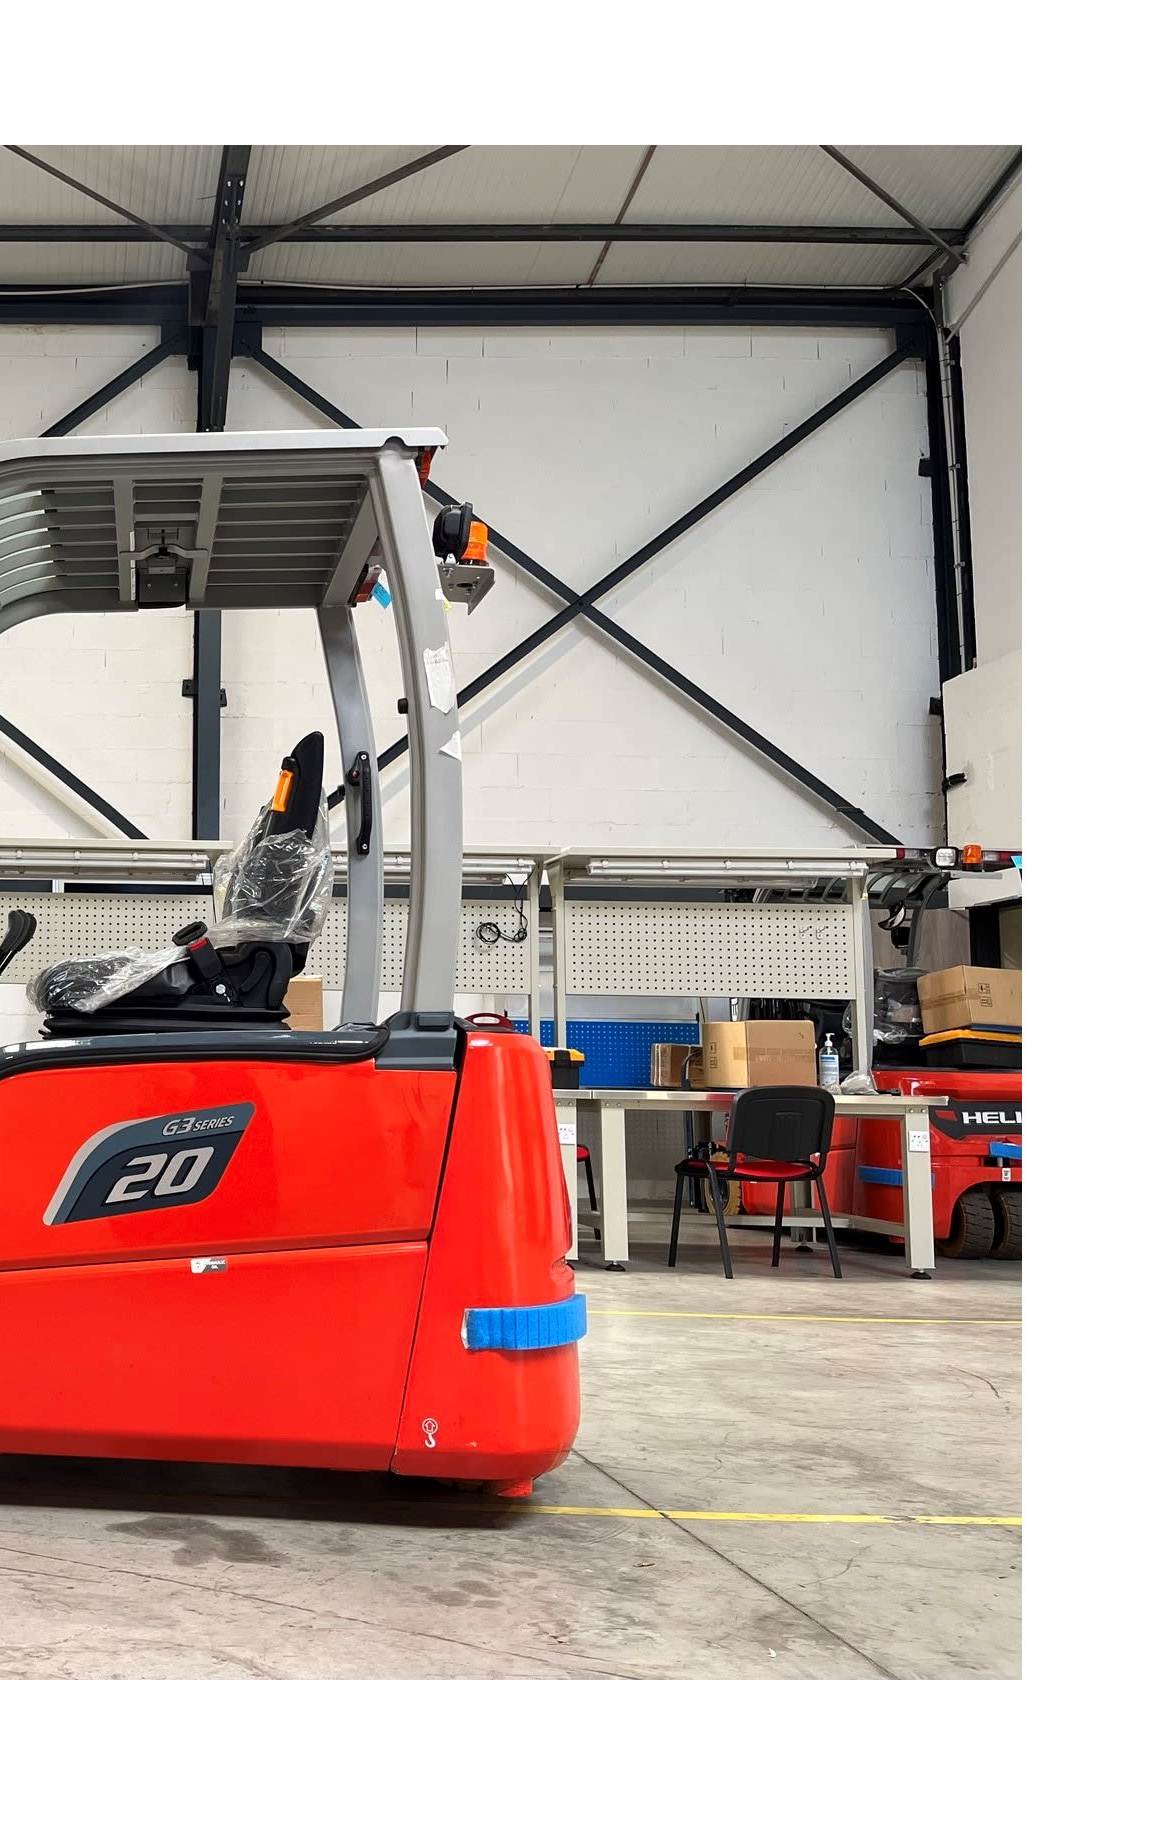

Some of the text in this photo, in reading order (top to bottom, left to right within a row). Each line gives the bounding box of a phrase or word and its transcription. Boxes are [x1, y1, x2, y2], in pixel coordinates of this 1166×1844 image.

[162, 1115, 235, 1136] G3 SERIES
[962, 1111, 1022, 1124] HELI
[104, 1145, 215, 1204] 20
